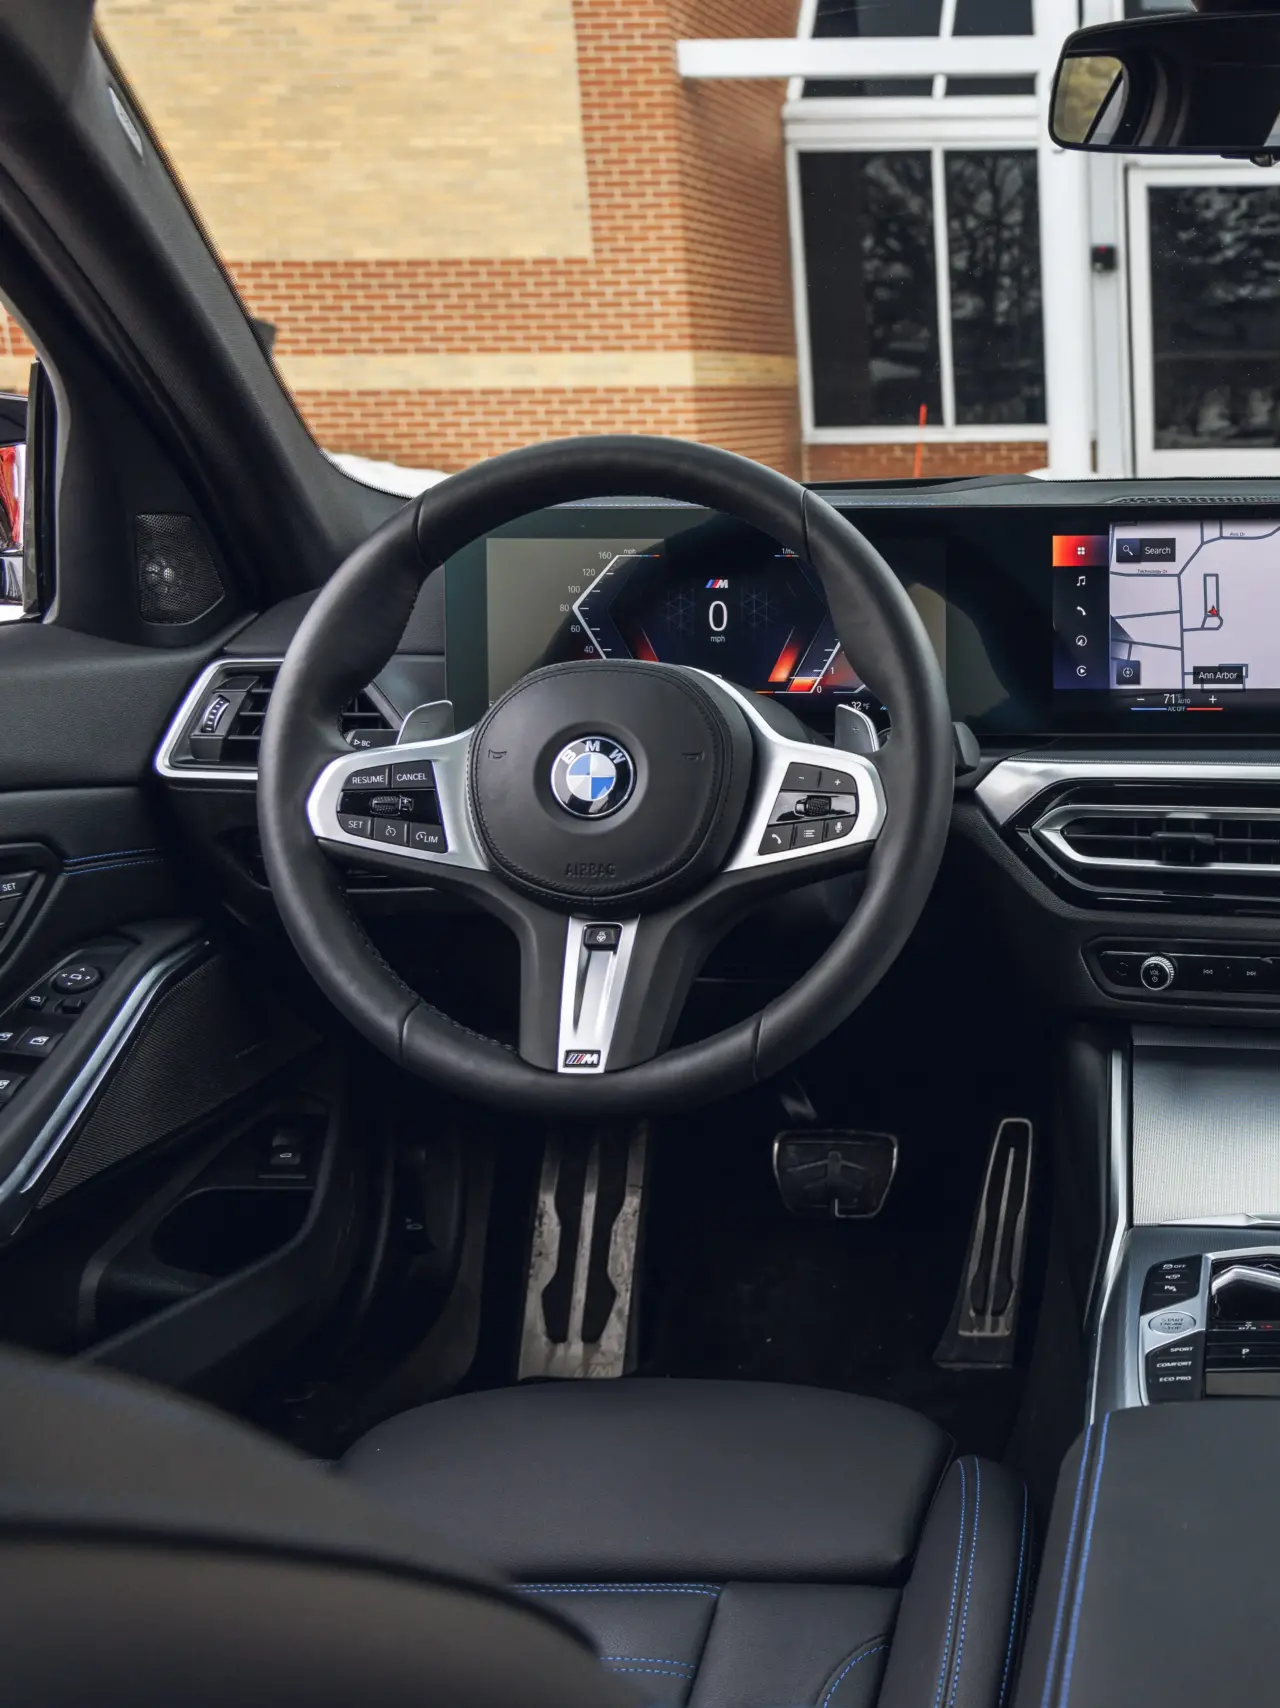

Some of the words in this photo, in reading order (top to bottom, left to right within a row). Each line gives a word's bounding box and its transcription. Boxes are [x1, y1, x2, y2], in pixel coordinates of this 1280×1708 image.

[1144, 546, 1171, 555] Search
[598, 552, 612, 560] 160
[582, 568, 596, 576] 120
[567, 585, 581, 594] 100
[559, 604, 570, 612] 80
[708, 600, 728, 632] 0
[570, 625, 581, 633] 60
[710, 635, 726, 643] mph
[584, 646, 594, 654] 40
[830, 667, 835, 675] 1
[1199, 671, 1215, 680] Ann
[1216, 671, 1238, 680] Arbor
[816, 686, 822, 694] 0
[1163, 693, 1175, 704] 71
[851, 701, 862, 711] 32
[561, 740, 627, 765] BMW
[352, 775, 385, 784] RESUME
[396, 773, 427, 782] CANCEL
[348, 820, 364, 829] SET
[424, 835, 438, 843] LIM
[2, 882, 16, 892] SET
